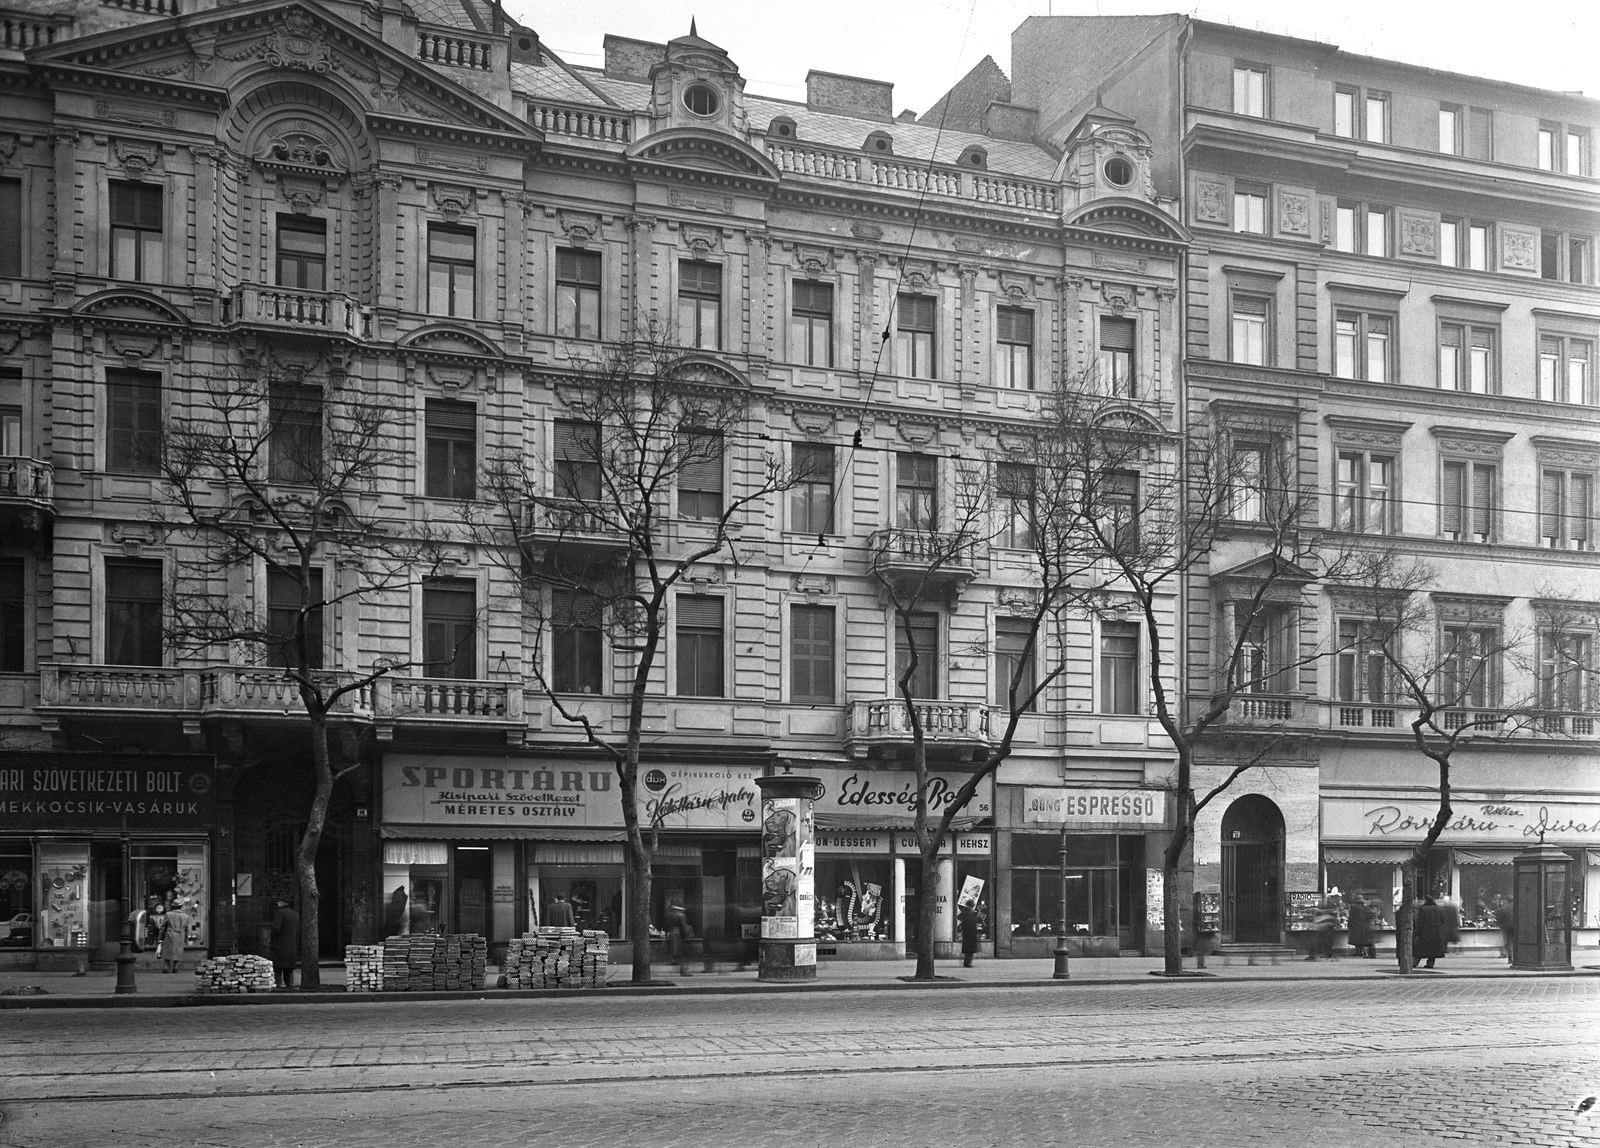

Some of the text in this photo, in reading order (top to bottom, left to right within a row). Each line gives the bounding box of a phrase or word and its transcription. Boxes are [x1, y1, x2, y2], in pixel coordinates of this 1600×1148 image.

[33, 766, 138, 792] SZÖVETKEZETI
[146, 771, 181, 793] BOLT
[402, 766, 612, 792] SPORTÁRU
[837, 773, 978, 811] Édesség Bo
[438, 791, 580, 803] Kisipari Szövetkezet
[444, 803, 576, 817] MÉRETES OSZTÁLY
[979, 803, 989, 812] 56
[1364, 806, 1499, 836] Röviáru
